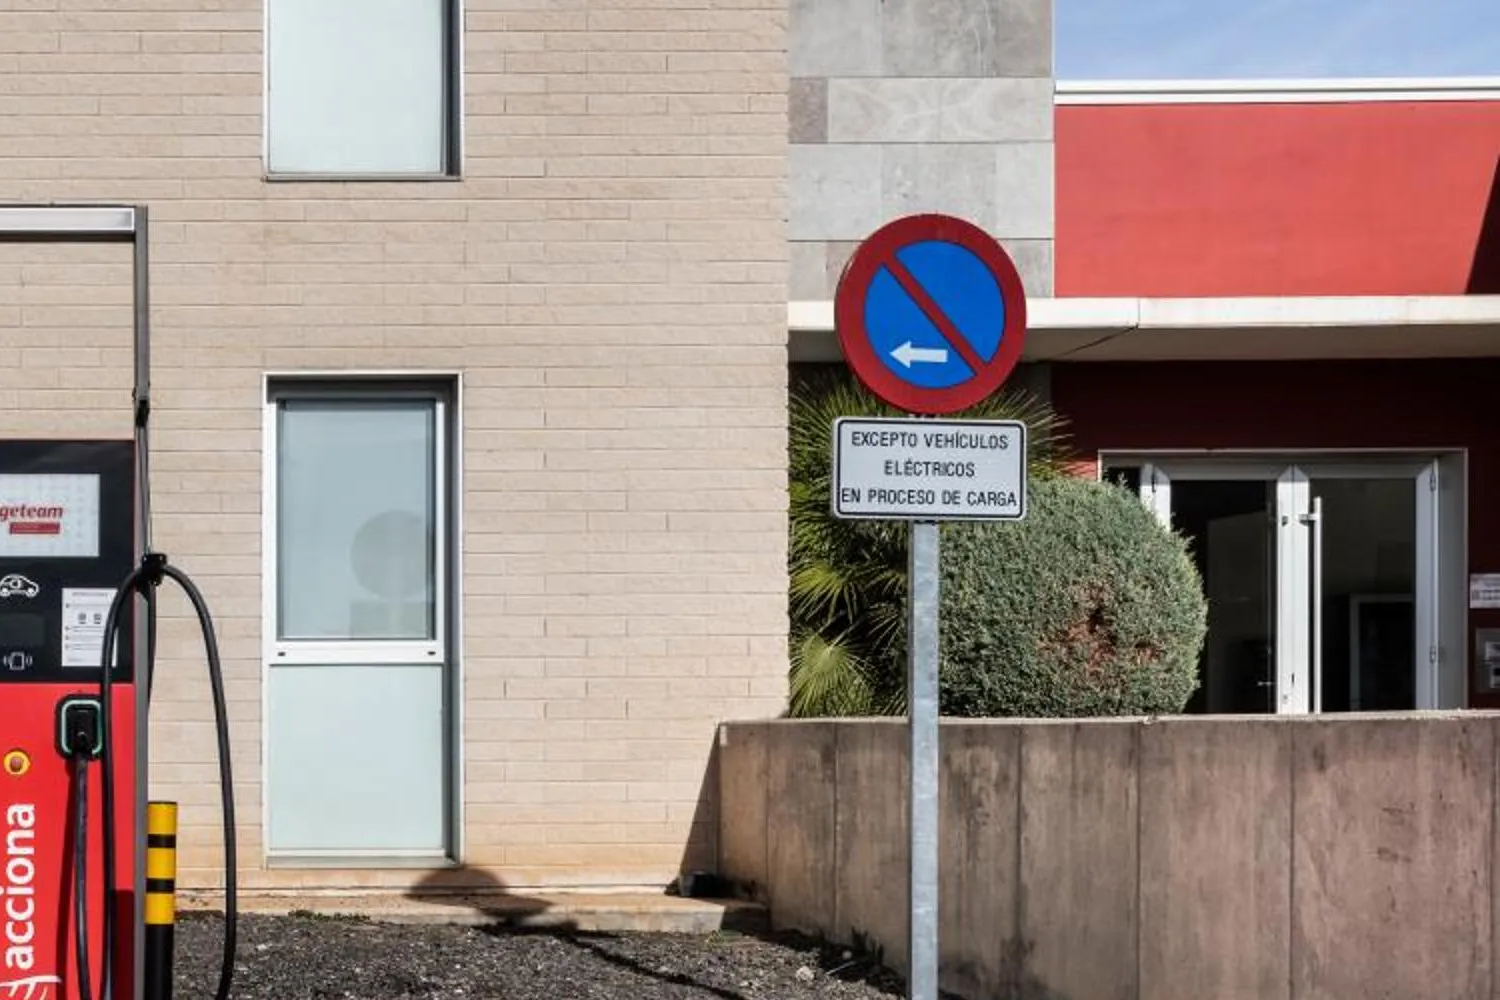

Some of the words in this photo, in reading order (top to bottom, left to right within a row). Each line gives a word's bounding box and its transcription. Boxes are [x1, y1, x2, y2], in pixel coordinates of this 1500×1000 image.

[851, 431, 918, 448] EXCEPTO
[924, 430, 1009, 450] VEHÍCULOS
[883, 457, 976, 478] ELÉCTRICOS
[841, 487, 861, 504] EN
[868, 489, 936, 505] PROCESO
[942, 490, 961, 505] DE
[967, 491, 1018, 507] CARGA
